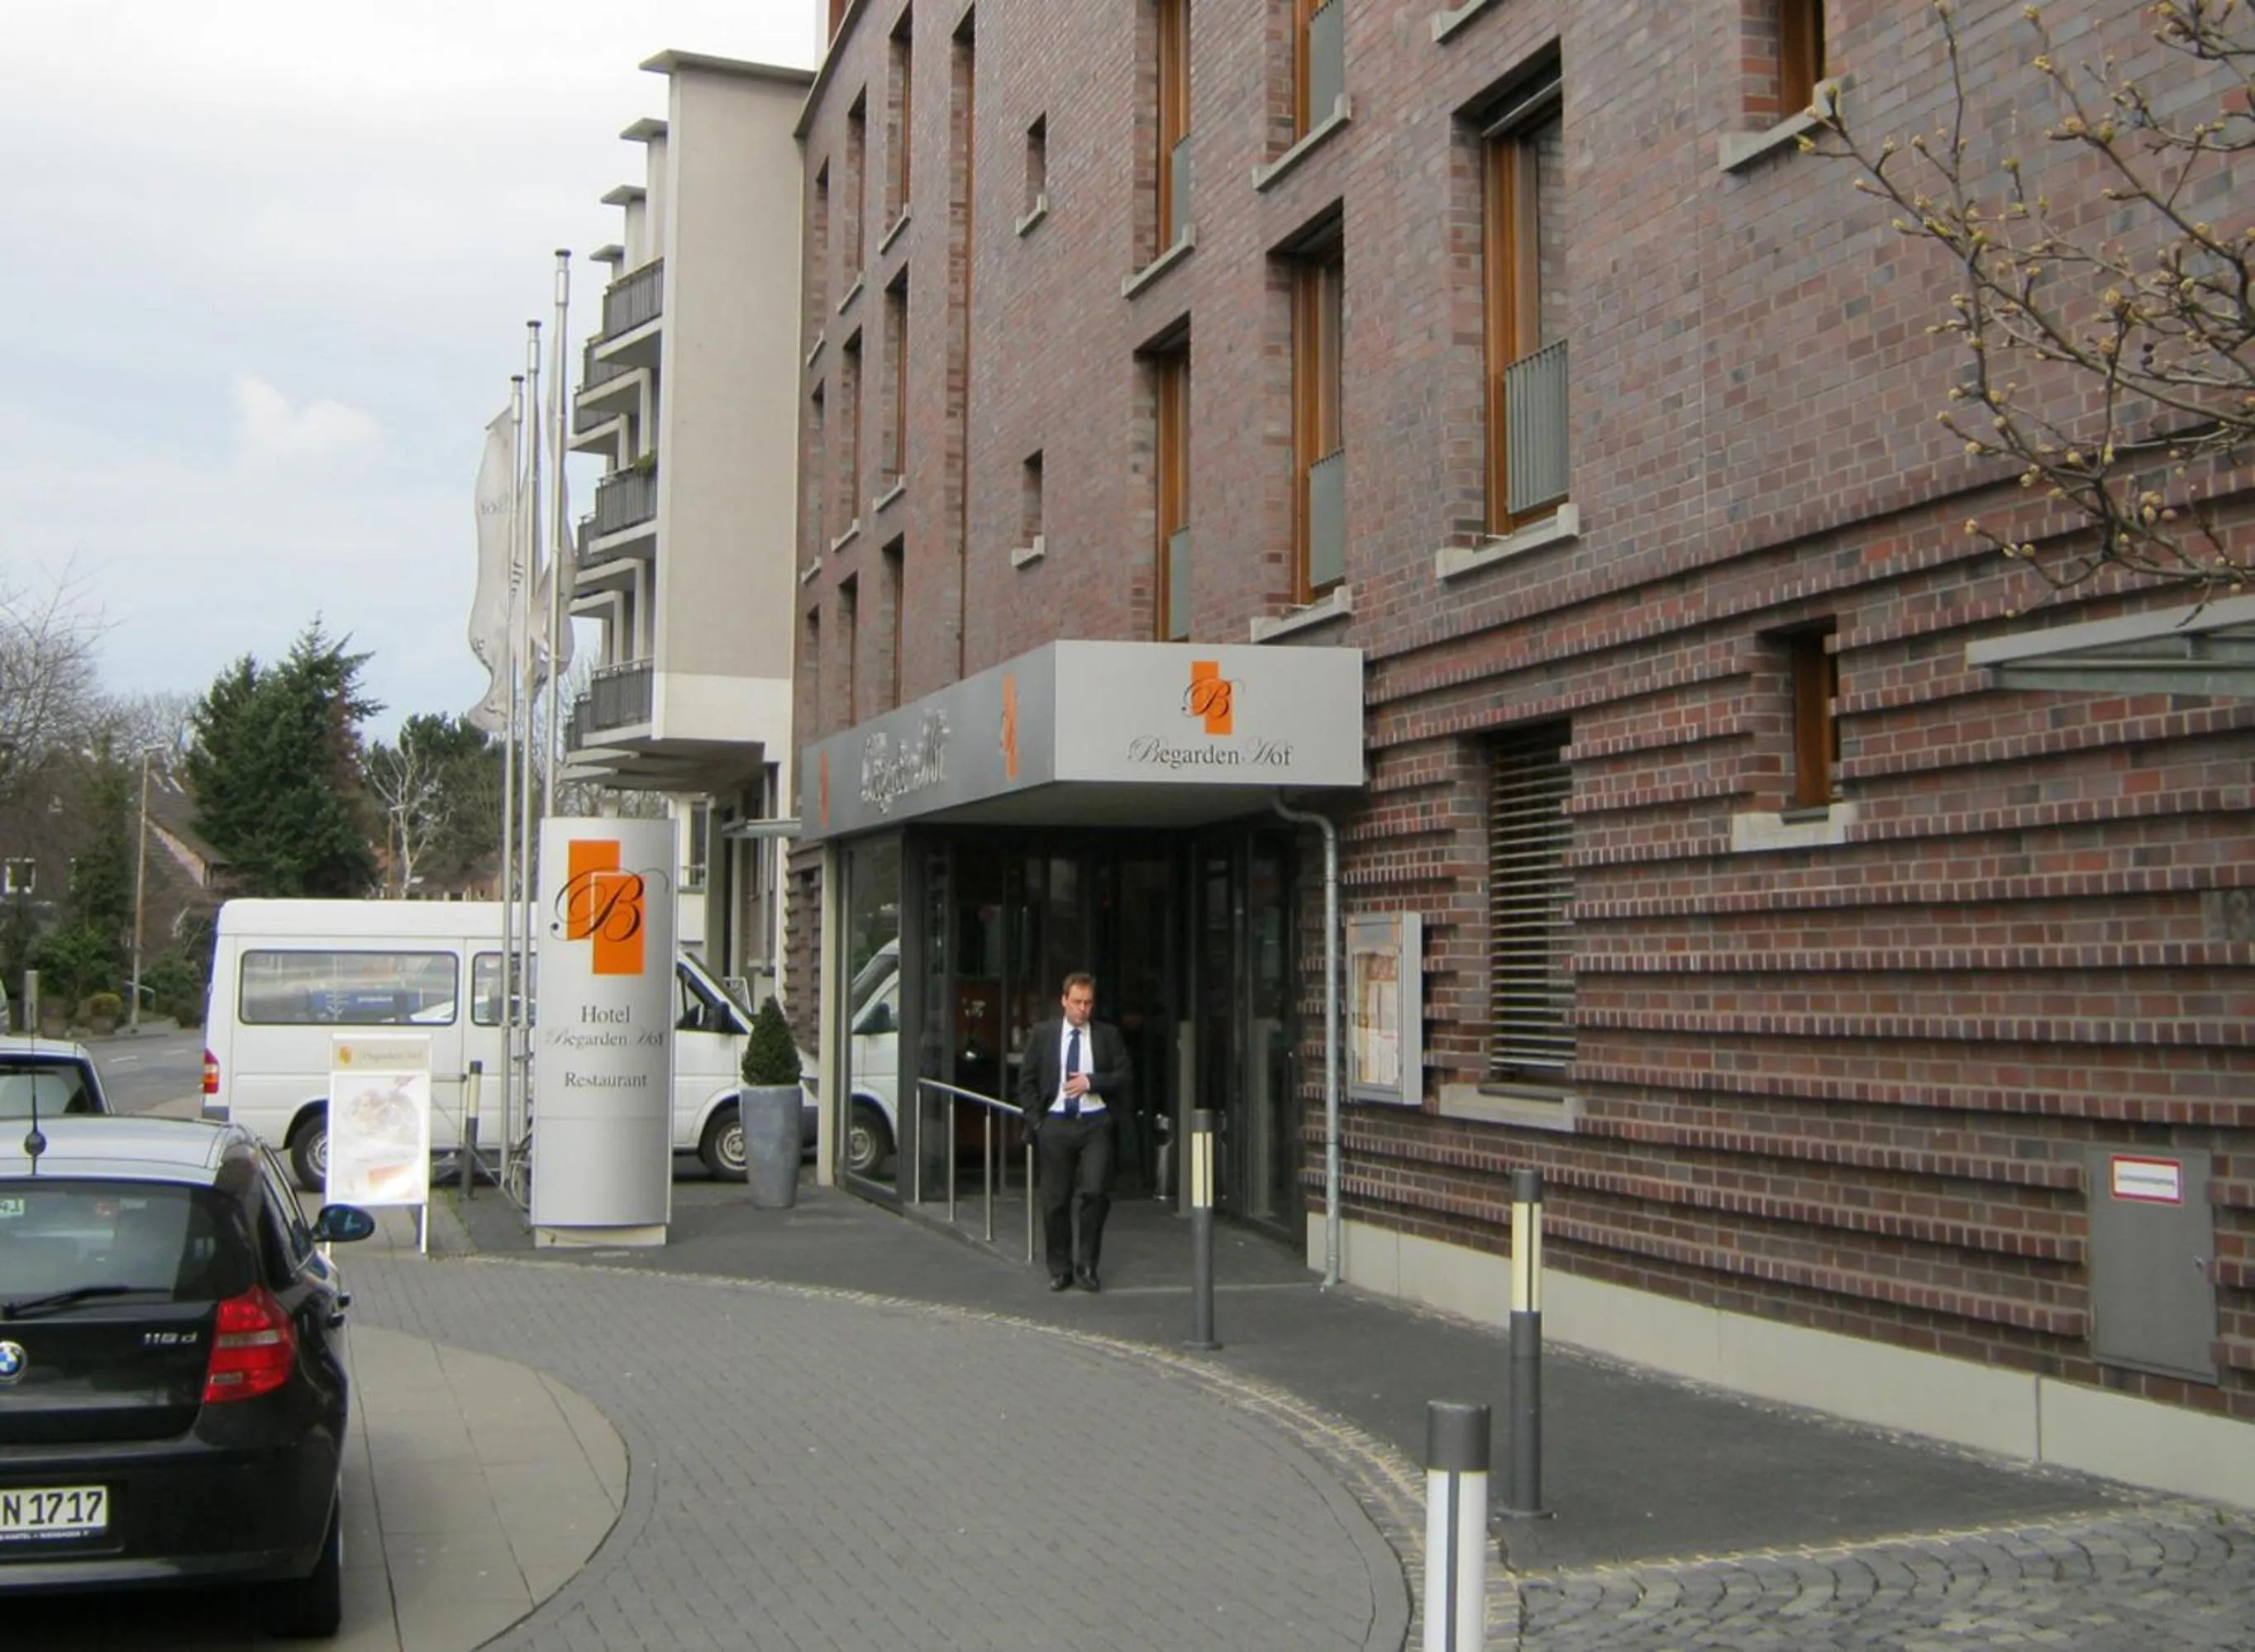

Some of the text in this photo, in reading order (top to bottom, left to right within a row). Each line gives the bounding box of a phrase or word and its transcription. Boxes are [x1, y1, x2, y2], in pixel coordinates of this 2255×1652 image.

[1181, 678, 1245, 718] B
[1128, 735, 1294, 769] Begarden Hof
[550, 867, 669, 941] B
[581, 1005, 631, 1023] Hotel
[545, 1027, 628, 1049] Begarden
[565, 1071, 647, 1088] Restaurant
[29, 1491, 102, 1524] 1717
